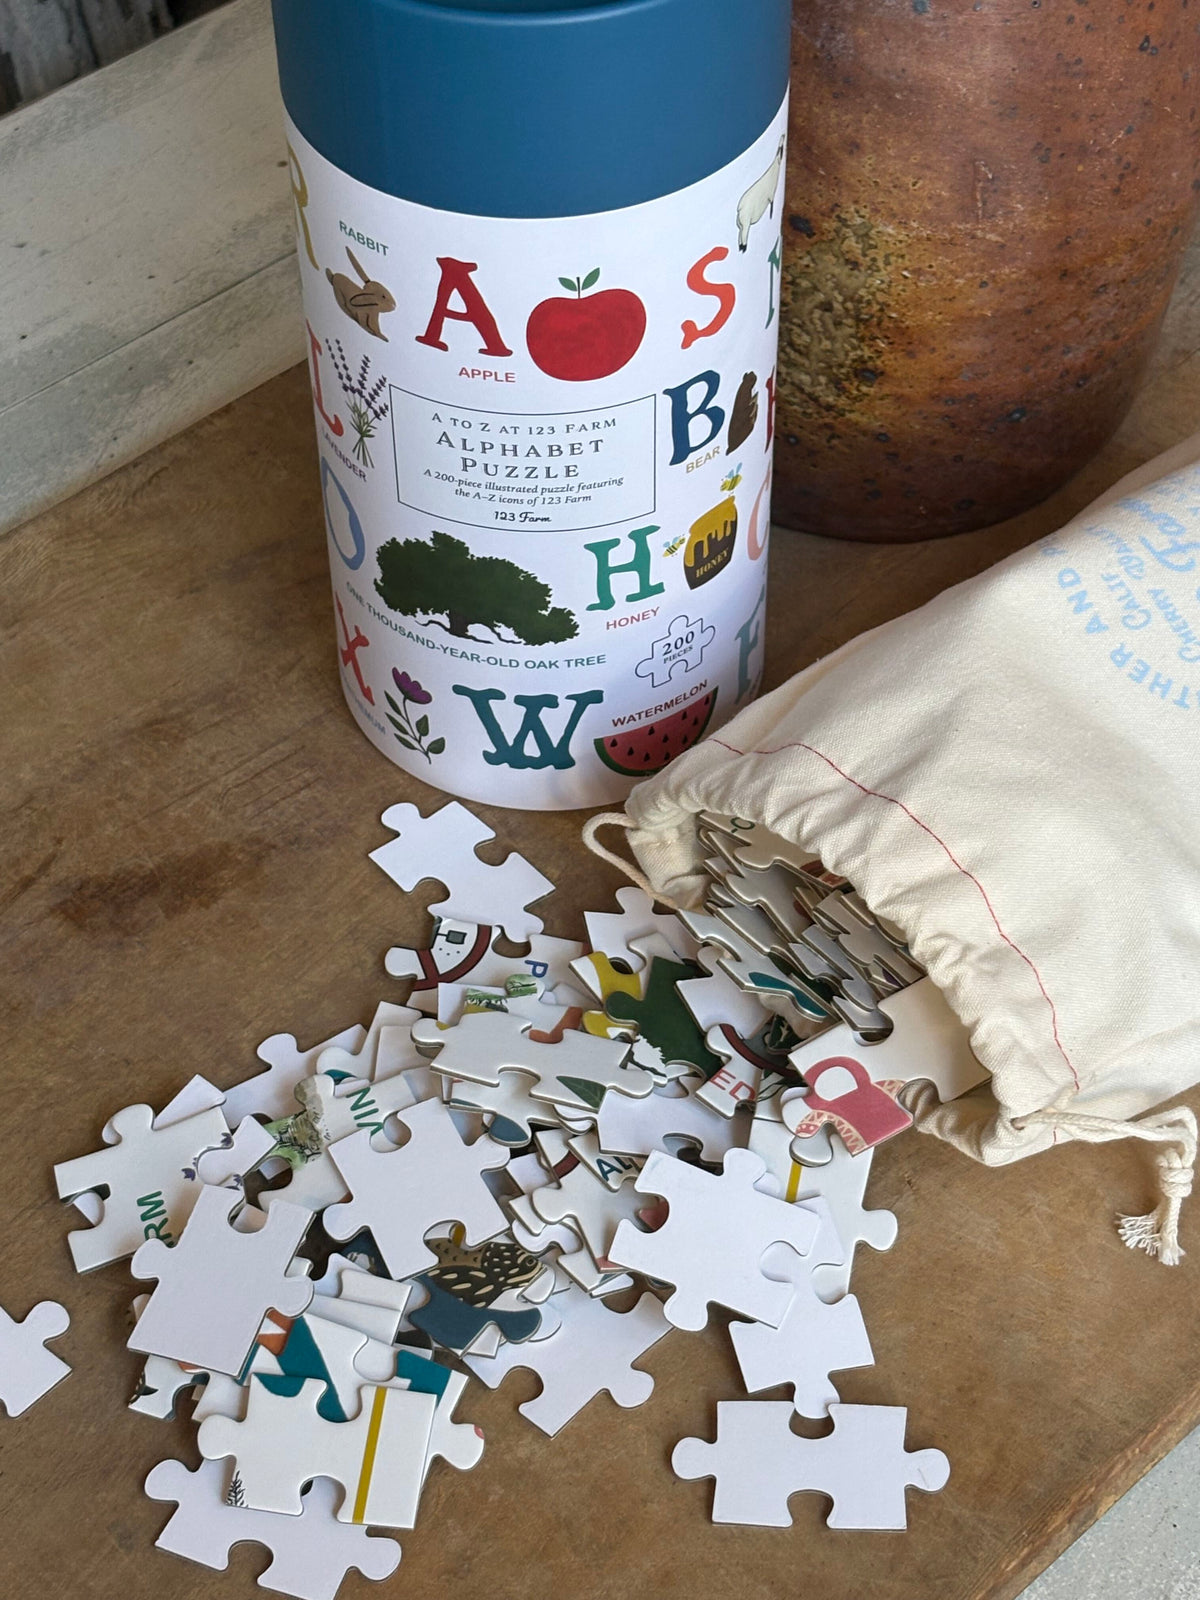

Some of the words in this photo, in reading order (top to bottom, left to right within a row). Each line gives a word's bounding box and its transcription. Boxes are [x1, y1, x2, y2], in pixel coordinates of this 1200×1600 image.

[338, 220, 390, 257] RABBIT
[415, 256, 514, 357] A
[680, 246, 736, 350] S
[458, 366, 517, 383] APPLE
[432, 412, 443, 423] A
[450, 417, 472, 430] TO
[480, 422, 491, 433] Z
[499, 425, 520, 435] AT
[528, 426, 556, 435] 123
[565, 417, 617, 434] FARM
[662, 369, 726, 466] B
[436, 431, 605, 458] ALPHABET
[460, 456, 580, 479] PUZZLE
[685, 445, 721, 475] BEAR
[423, 468, 432, 477] A
[434, 471, 482, 489] 200-piece
[485, 481, 538, 493] illustrated
[540, 484, 575, 496] puzzle
[576, 477, 624, 493] featuring
[455, 487, 470, 497] the
[499, 494, 524, 505] icons
[527, 496, 540, 507] of
[541, 496, 561, 505] 123
[565, 494, 592, 504] Farm
[494, 510, 516, 521] 123
[519, 511, 552, 523] Farm
[583, 524, 666, 612] H
[696, 547, 730, 578] HONEY
[1056, 567, 1110, 635] AND
[346, 581, 366, 607] ONE
[366, 602, 520, 669] THOUSAND-YEAR-OLD
[524, 659, 559, 670] OAK
[564, 654, 607, 668] TREE
[606, 607, 660, 631] HONEY
[662, 630, 695, 656] 200
[663, 645, 693, 665] PIECES
[611, 679, 708, 728] WATERMELON
[451, 684, 605, 770] W
[524, 959, 549, 979] P
